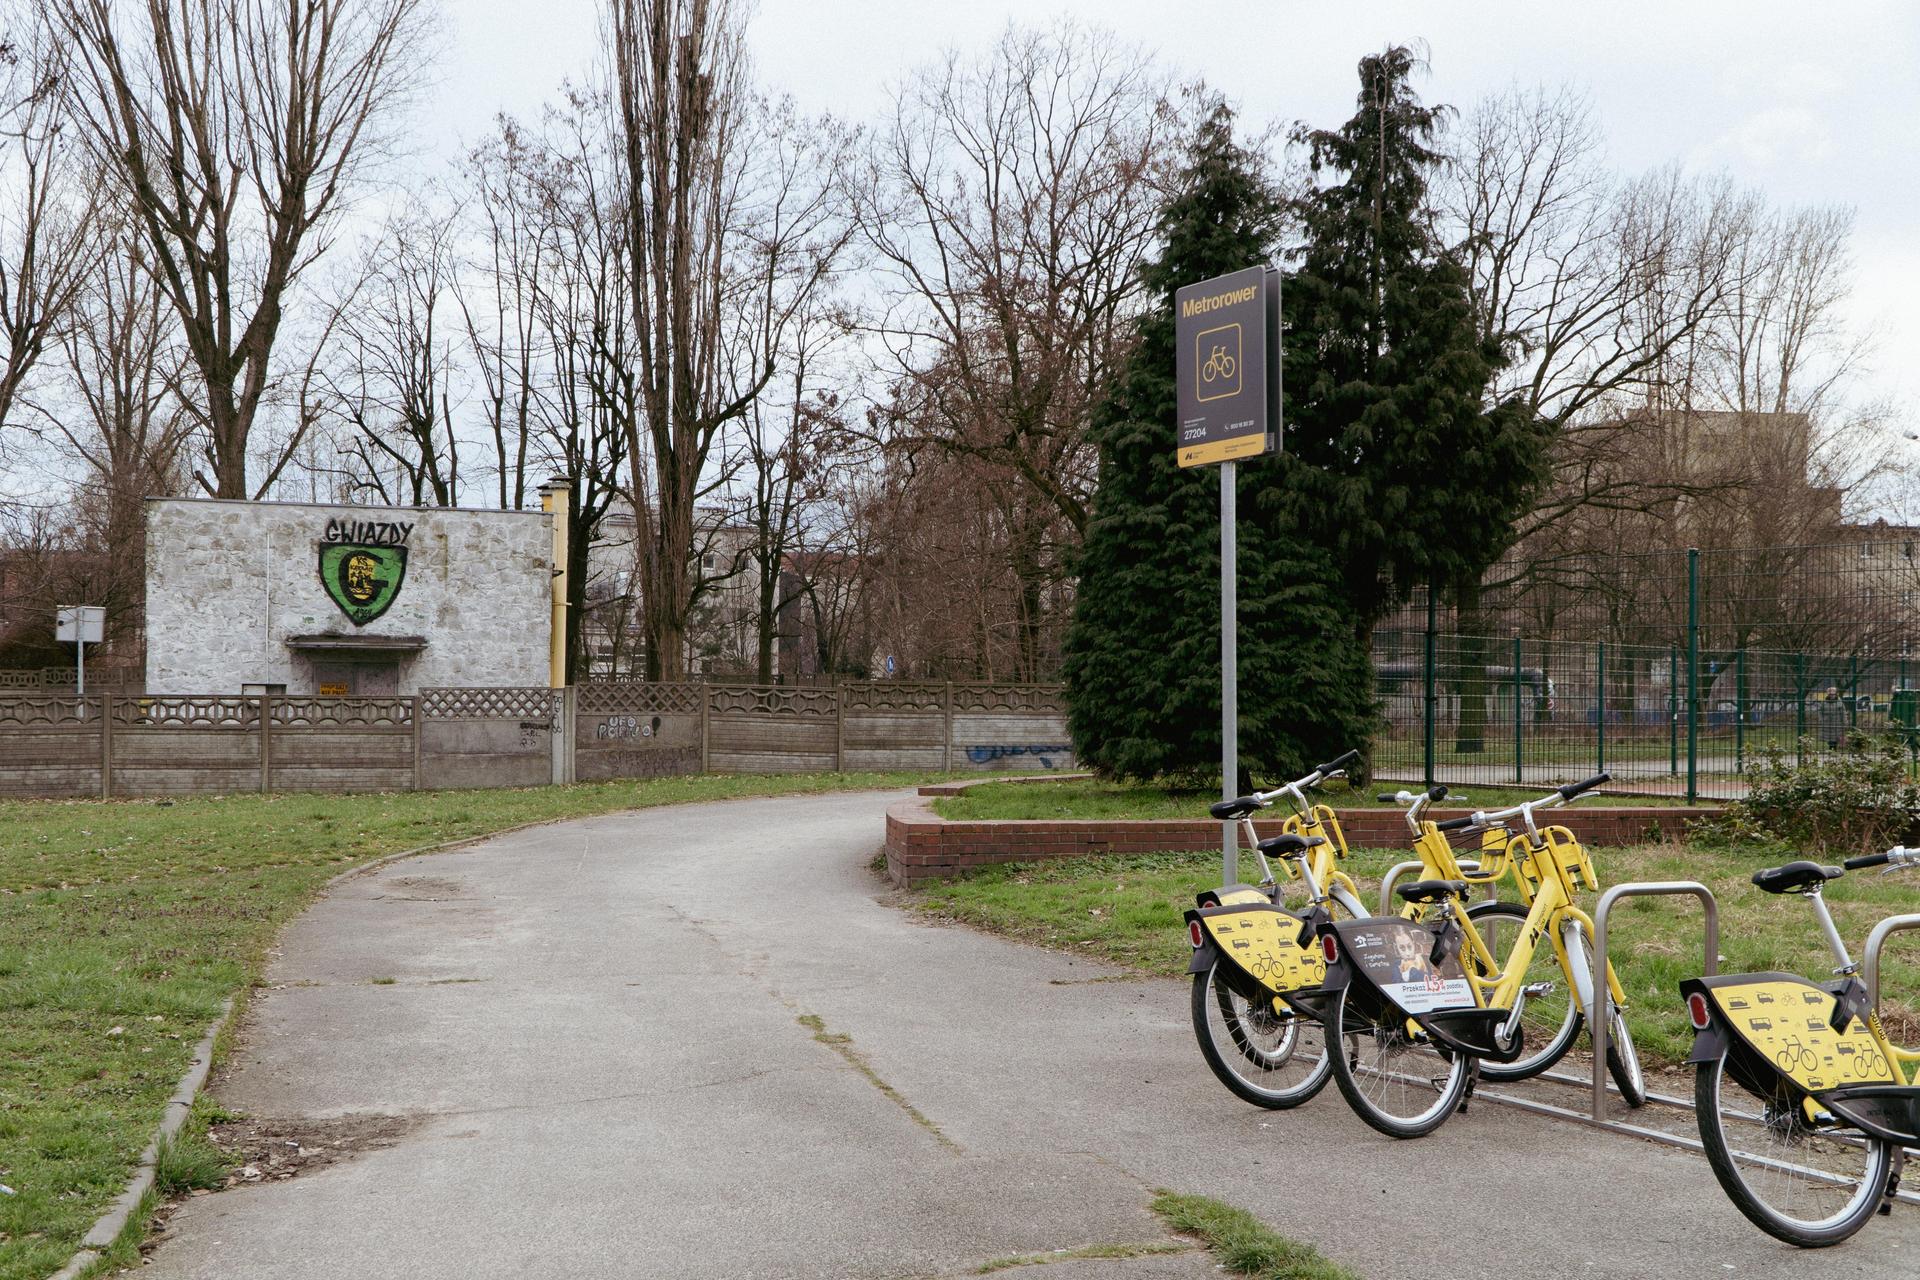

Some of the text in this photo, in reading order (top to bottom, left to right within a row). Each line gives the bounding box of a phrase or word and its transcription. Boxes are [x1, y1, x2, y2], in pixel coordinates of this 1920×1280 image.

[1183, 285, 1257, 318] Metrorower
[1184, 427, 1207, 440] 27204
[326, 518, 414, 544] GWIAZDY
[608, 715, 636, 728] UFO
